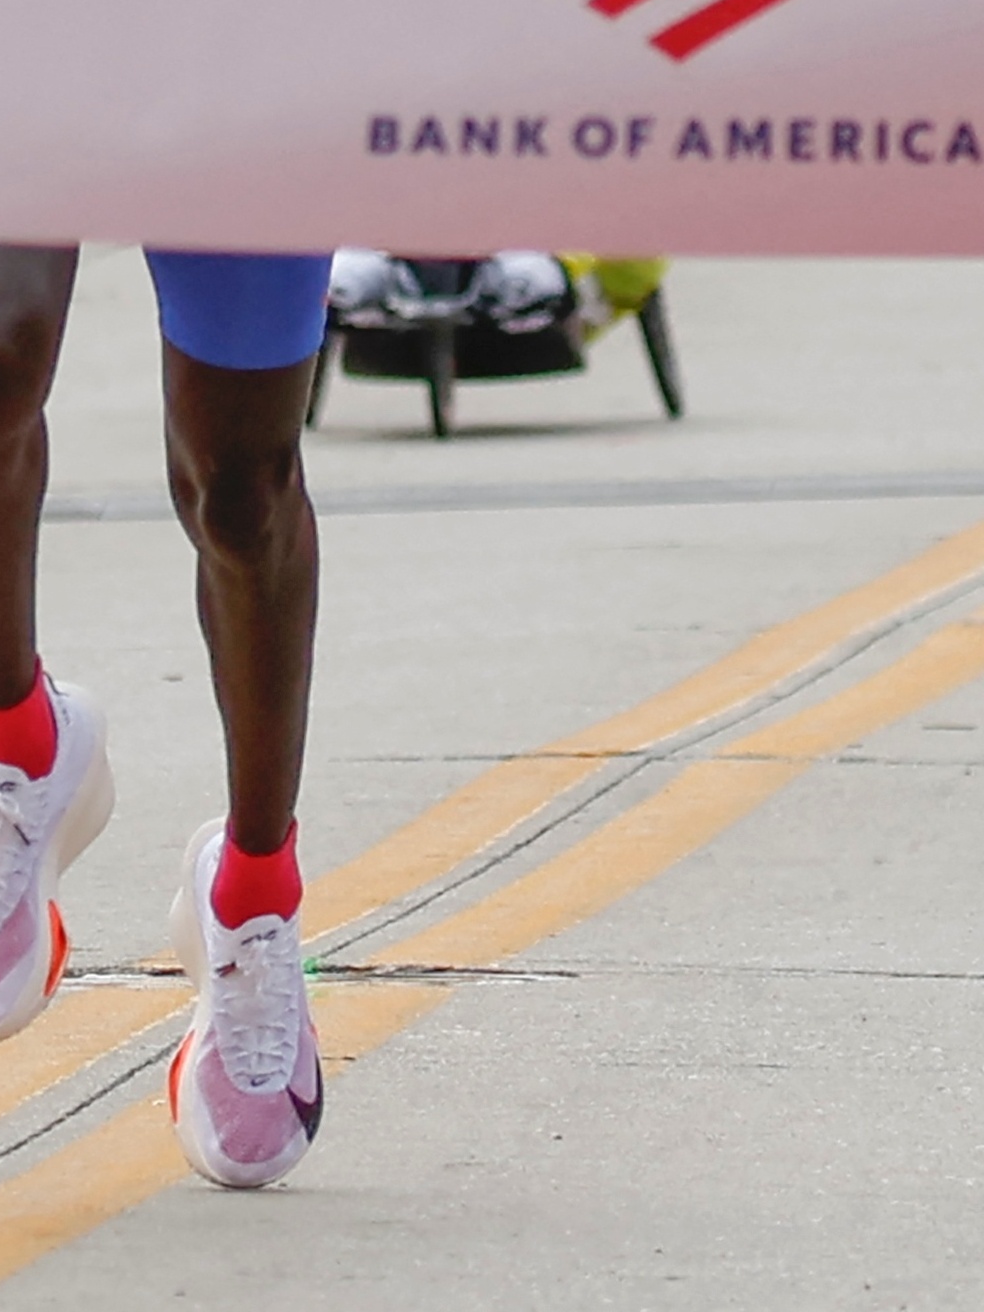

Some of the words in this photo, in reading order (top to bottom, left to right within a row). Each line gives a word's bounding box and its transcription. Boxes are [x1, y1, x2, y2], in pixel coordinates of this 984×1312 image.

[367, 115, 548, 157] BANK
[571, 116, 654, 160] OF
[674, 117, 984, 166] AMERICA
